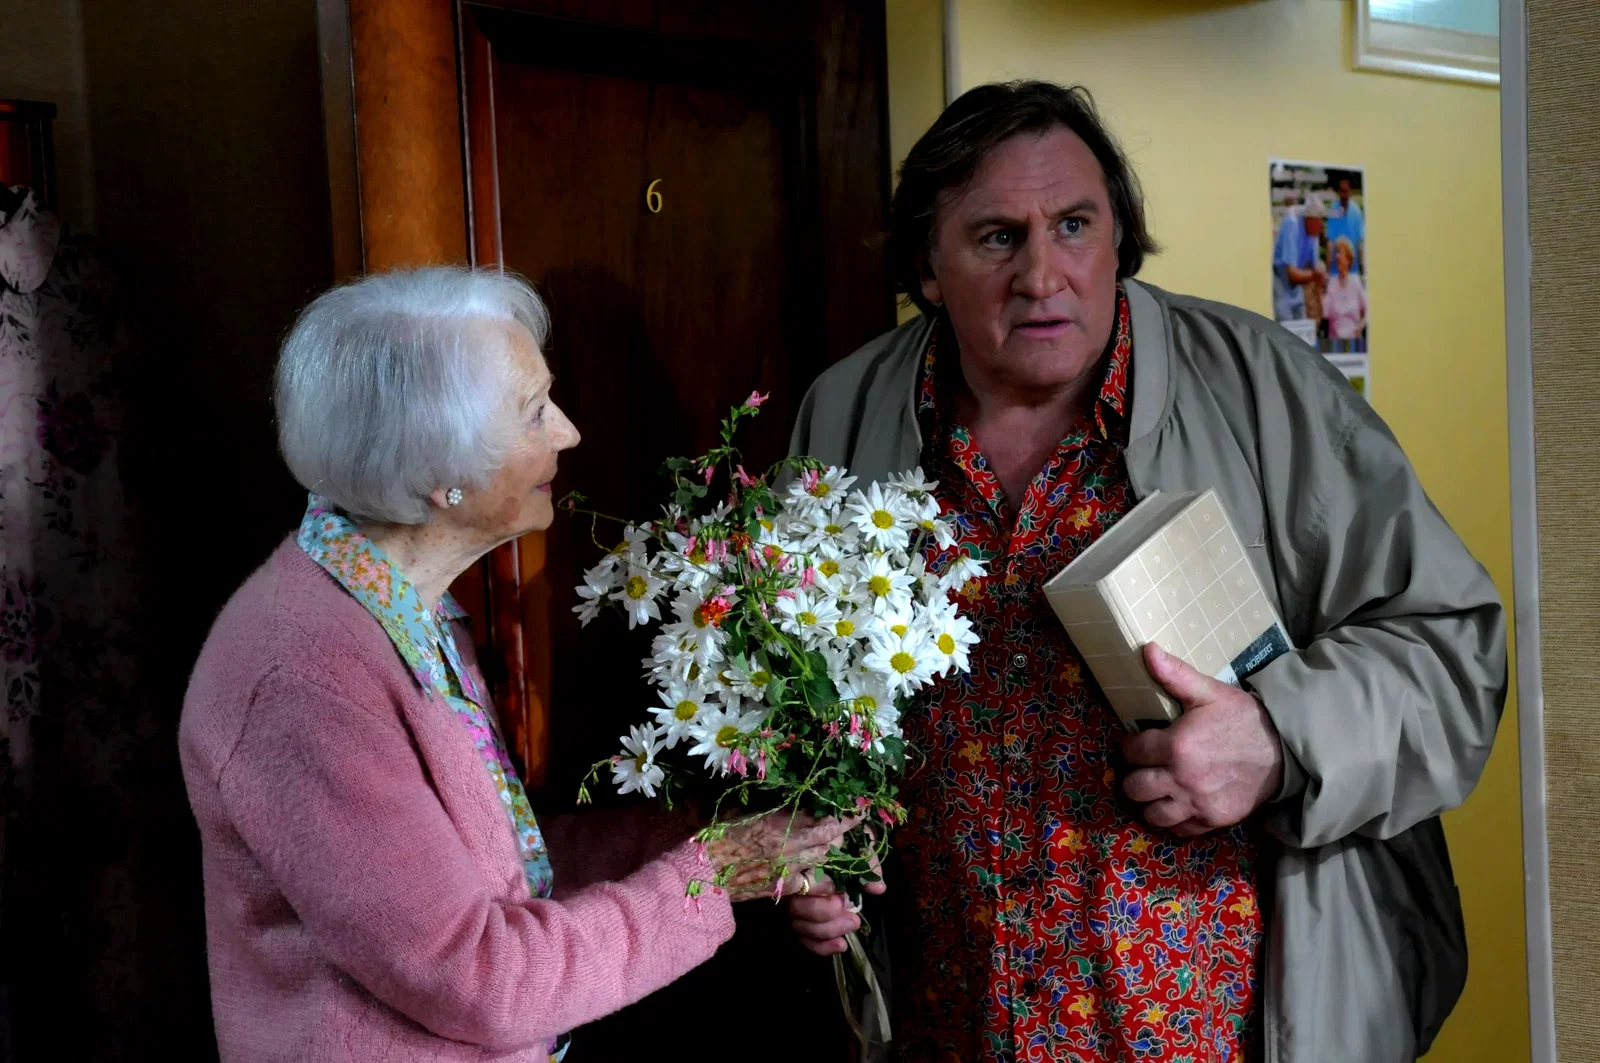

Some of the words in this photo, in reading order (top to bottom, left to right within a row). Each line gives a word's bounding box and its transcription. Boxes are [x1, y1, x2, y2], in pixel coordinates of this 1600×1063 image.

[646, 178, 662, 213] 6
[1130, 577, 1137, 587] A
[1204, 513, 1211, 522] D
[1146, 610, 1154, 620] E
[1219, 545, 1228, 555] H
[1188, 620, 1197, 630] K
[1213, 600, 1221, 609] L
[1206, 653, 1213, 662] O
[1229, 631, 1236, 641] P
[1245, 643, 1274, 672] ROBERT
